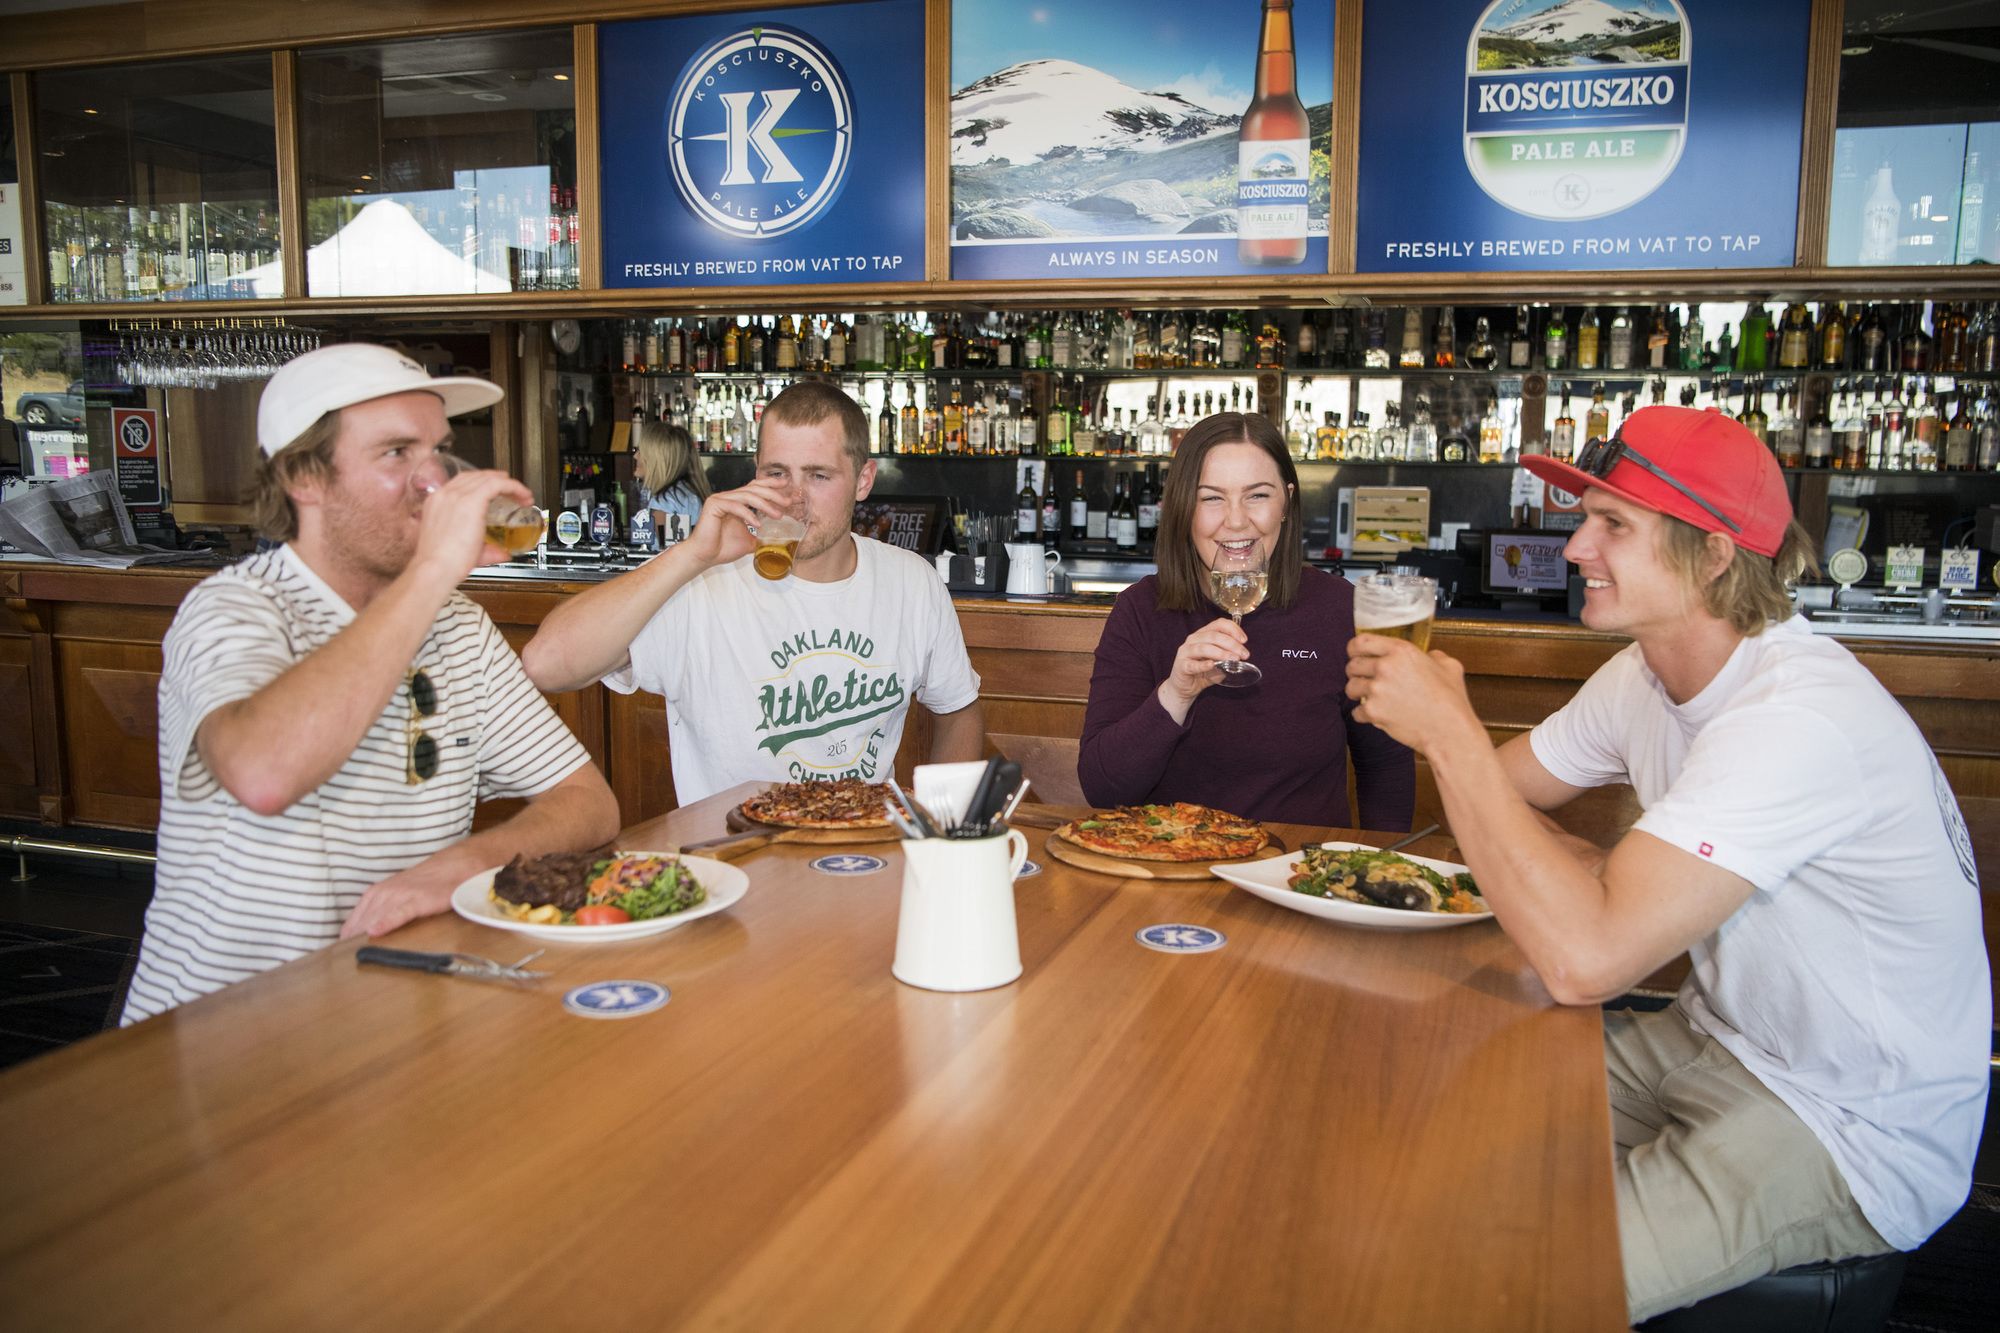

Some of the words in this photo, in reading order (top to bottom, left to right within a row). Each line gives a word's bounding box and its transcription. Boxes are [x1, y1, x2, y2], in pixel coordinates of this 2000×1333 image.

[695, 50, 822, 102] KOSCIUSZKO
[1478, 75, 1674, 113] KOSCIUSZKO
[719, 88, 804, 186] K
[1511, 141, 1575, 161] PALE
[1584, 139, 1636, 158] ALE
[1239, 184, 1308, 200] KOSCIUSZKO
[711, 192, 758, 219] PALE
[773, 188, 808, 216] ALE
[1251, 213, 1274, 222] PALE
[1277, 213, 1295, 221] ALE
[1386, 242, 1474, 258] FRESHLY
[1481, 240, 1565, 256] BREWED
[1572, 238, 1631, 254] FROM
[1638, 236, 1678, 253] VAT
[1685, 236, 1712, 252] TO
[1720, 235, 1760, 251] TAP
[625, 263, 690, 277] FRESHLY
[695, 261, 757, 275] BREWED
[763, 259, 806, 273] FROM
[811, 258, 842, 272] VAT
[845, 257, 867, 270] TO
[872, 256, 903, 270] TAP
[1048, 251, 1116, 267] ALWAYS
[1122, 250, 1139, 265] IN
[1145, 249, 1219, 264] SEASON
[127, 429, 144, 446] 18
[891, 514, 926, 531] FREE
[888, 532, 918, 549] POOL
[770, 628, 875, 670] OAKLAND
[1281, 649, 1318, 659] RVCA
[755, 668, 903, 732] Athletics
[1162, 929, 1202, 945] K
